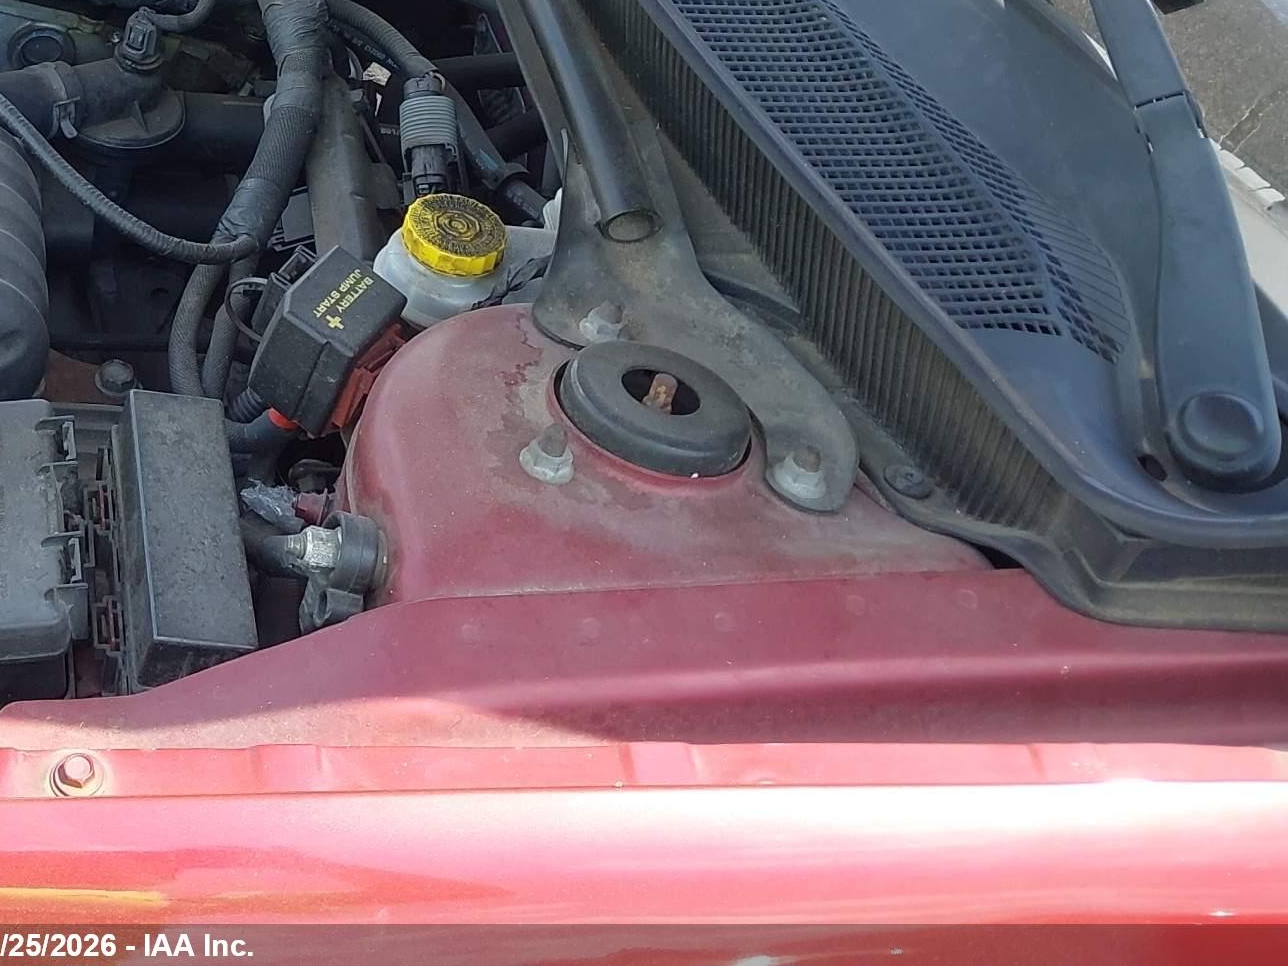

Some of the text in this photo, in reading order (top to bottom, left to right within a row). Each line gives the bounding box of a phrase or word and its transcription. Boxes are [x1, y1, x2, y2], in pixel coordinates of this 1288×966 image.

[312, 268, 362, 318] JUMP START
[335, 276, 374, 314] BATTERY
